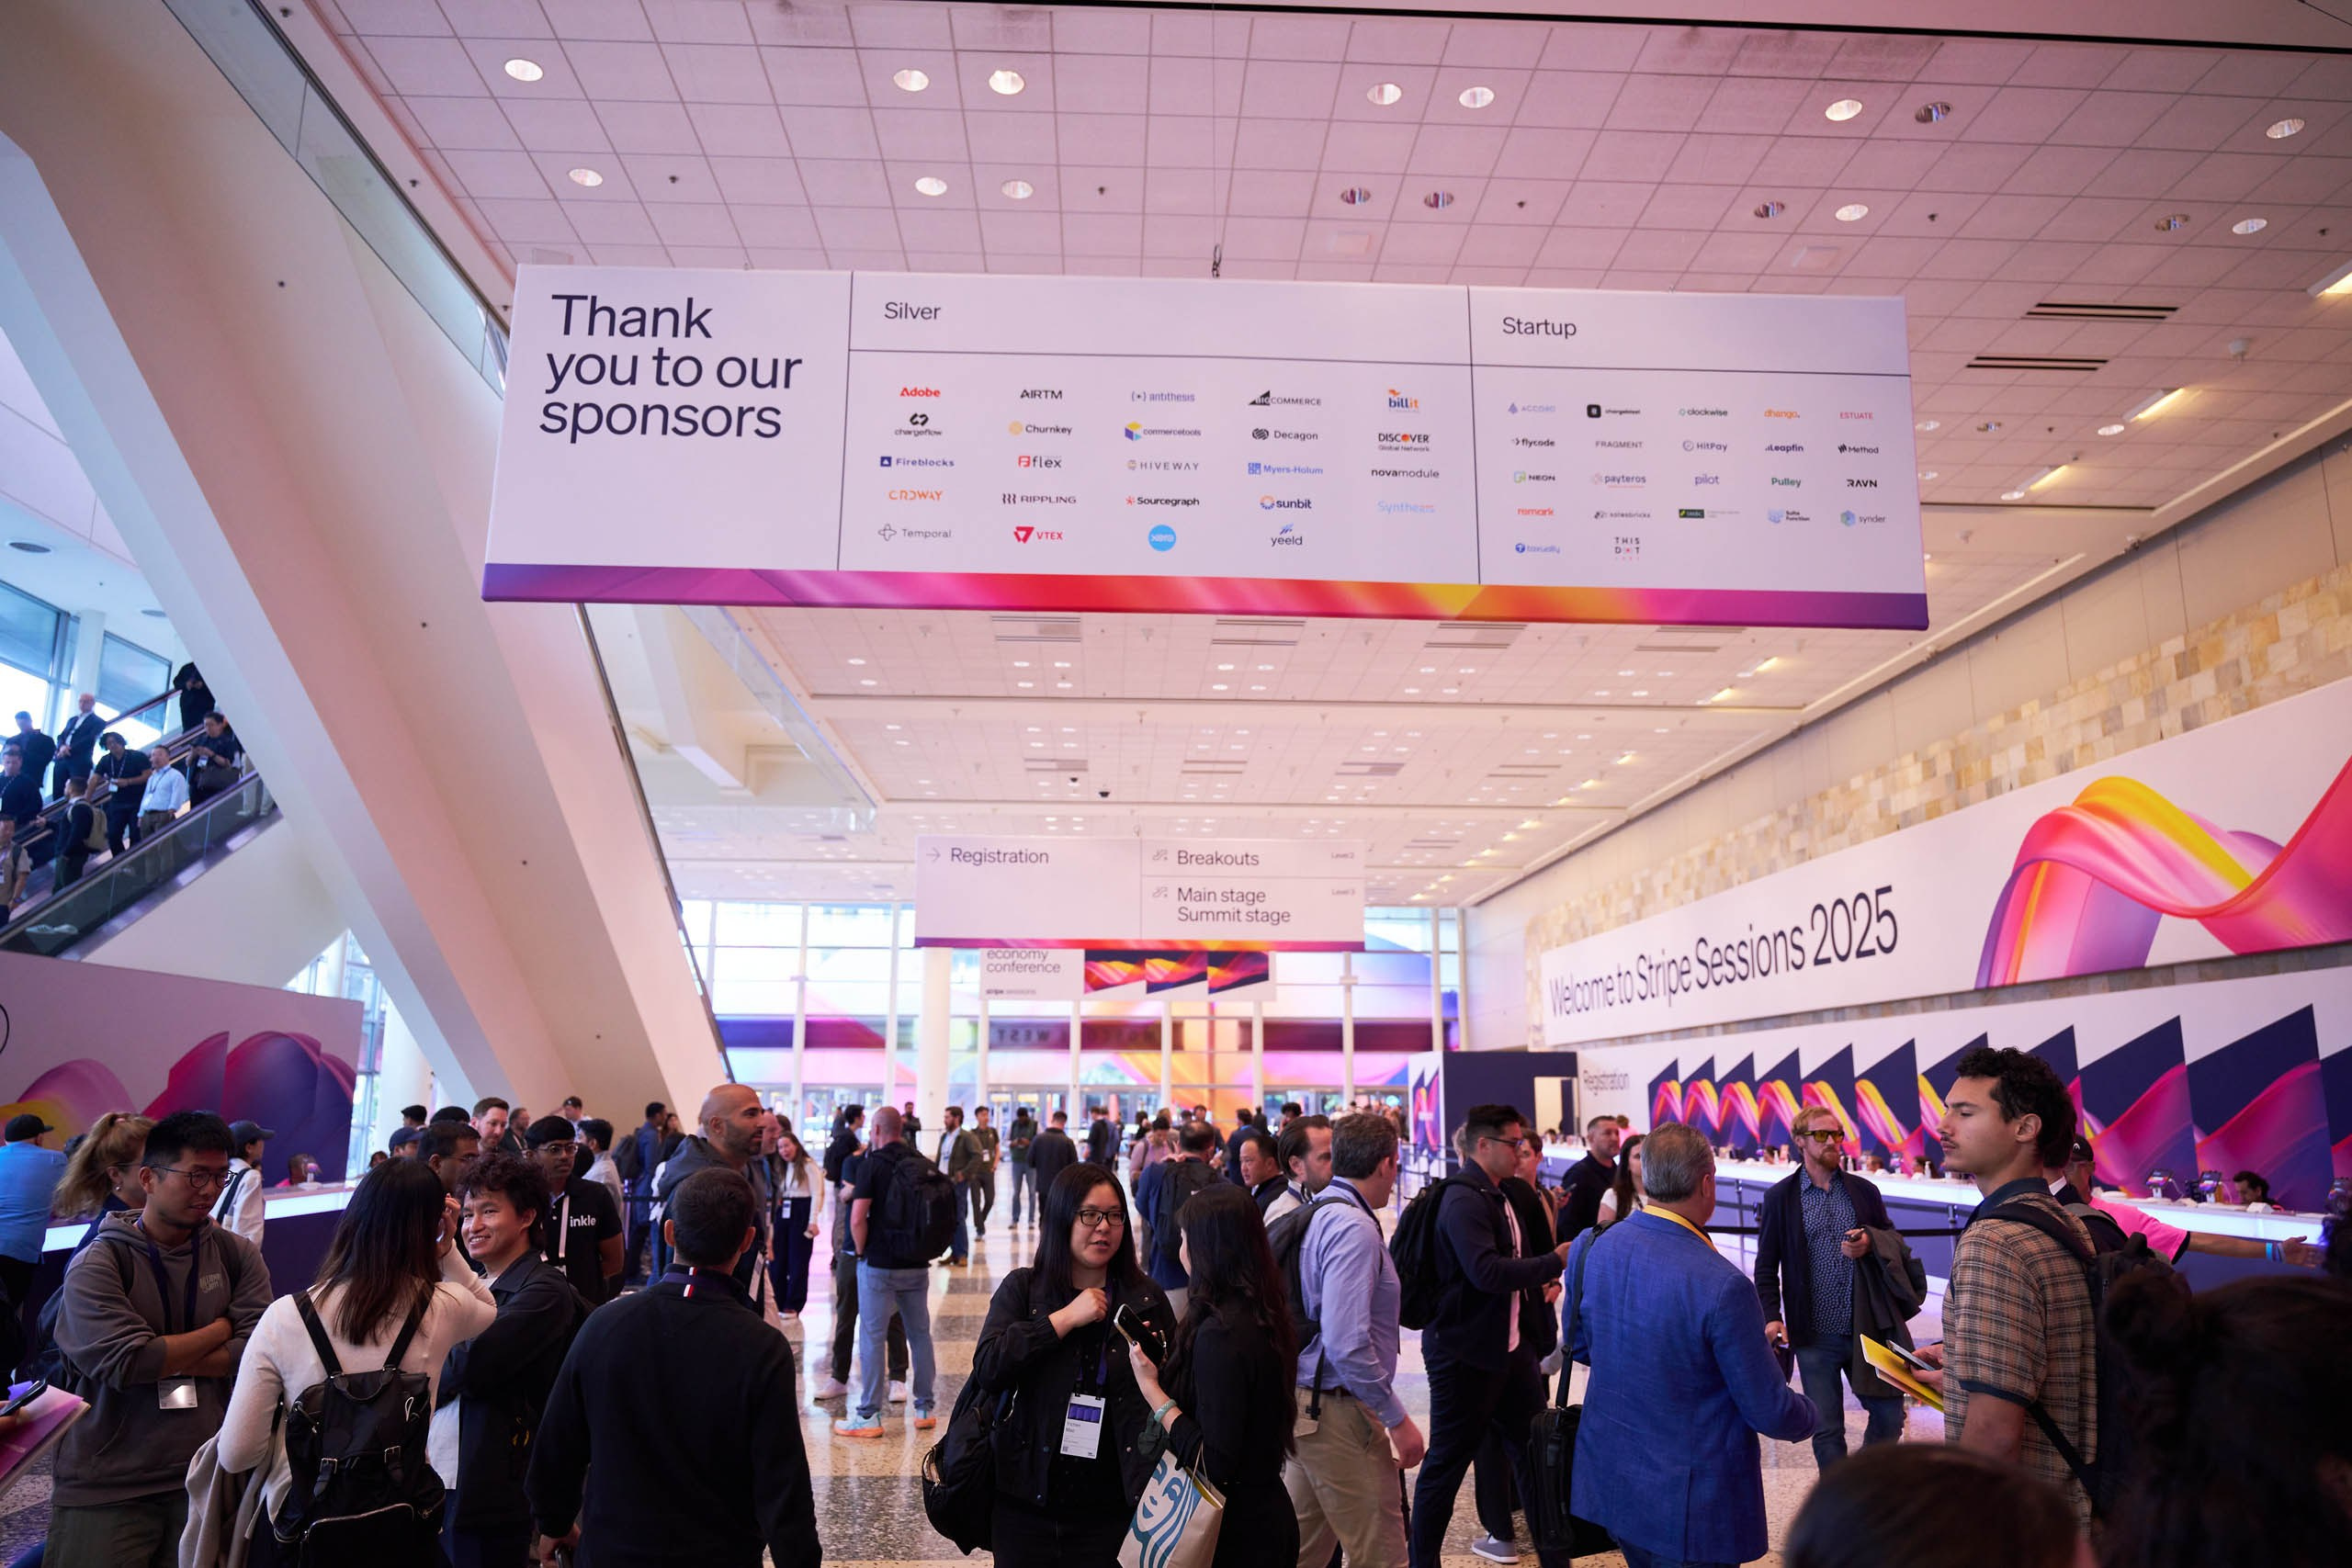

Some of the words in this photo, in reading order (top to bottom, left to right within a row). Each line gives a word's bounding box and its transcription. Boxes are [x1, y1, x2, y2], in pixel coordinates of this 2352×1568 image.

[551, 294, 713, 338] Thank
[884, 301, 941, 320] Silver
[1502, 317, 1577, 339] Startup
[545, 353, 639, 394] you
[651, 347, 703, 387] to
[716, 356, 803, 389] our
[899, 388, 941, 397] Adobe
[1020, 389, 1062, 400] AIRTM
[1149, 392, 1194, 402] antithesis
[1388, 398, 1419, 409] billit
[1839, 412, 1873, 420] ESTUATE
[539, 401, 782, 444] sponsors
[1025, 424, 1072, 435] Churnkey
[1143, 428, 1202, 436] commercetools
[1274, 431, 1318, 441] Decagon
[1521, 438, 1555, 448] flycode
[1595, 440, 1643, 448] FRAGMENT
[1697, 442, 1728, 452] HitPay
[1770, 444, 1804, 453] Leapfin
[896, 457, 955, 467] Fireblocks
[1033, 456, 1061, 468] flex
[1140, 462, 1199, 470] HIVEWAY
[1264, 464, 1323, 475] Myers-Holum
[1371, 468, 1440, 479] novamodule
[1694, 474, 1719, 486] pilot
[1771, 478, 1802, 488] Pulley
[1847, 479, 1877, 488] RAVN
[1021, 495, 1077, 503] RIPPLING
[1137, 497, 1200, 507] Sourcegraph
[1276, 499, 1312, 509] sunbit
[1859, 514, 1885, 524] synder
[901, 528, 952, 538] Temporal
[1036, 531, 1064, 540] VTEX
[1271, 536, 1303, 547] yeeld
[951, 847, 1049, 864] Registration
[1177, 850, 1260, 866] Breakouts
[1177, 888, 1216, 903] Main
[1221, 889, 1265, 907] stage
[1177, 907, 1241, 922] Summit
[1245, 908, 1291, 926] stage
[987, 950, 1048, 962] economy
[1550, 973, 1614, 1018] Welcome
[1617, 963, 1633, 1004] to
[1636, 949, 1691, 1007] Stripe
[1695, 924, 1805, 988] Sessions
[1811, 885, 1898, 966] 2025
[987, 961, 1060, 973] conference
[570, 1214, 596, 1227] inkle
